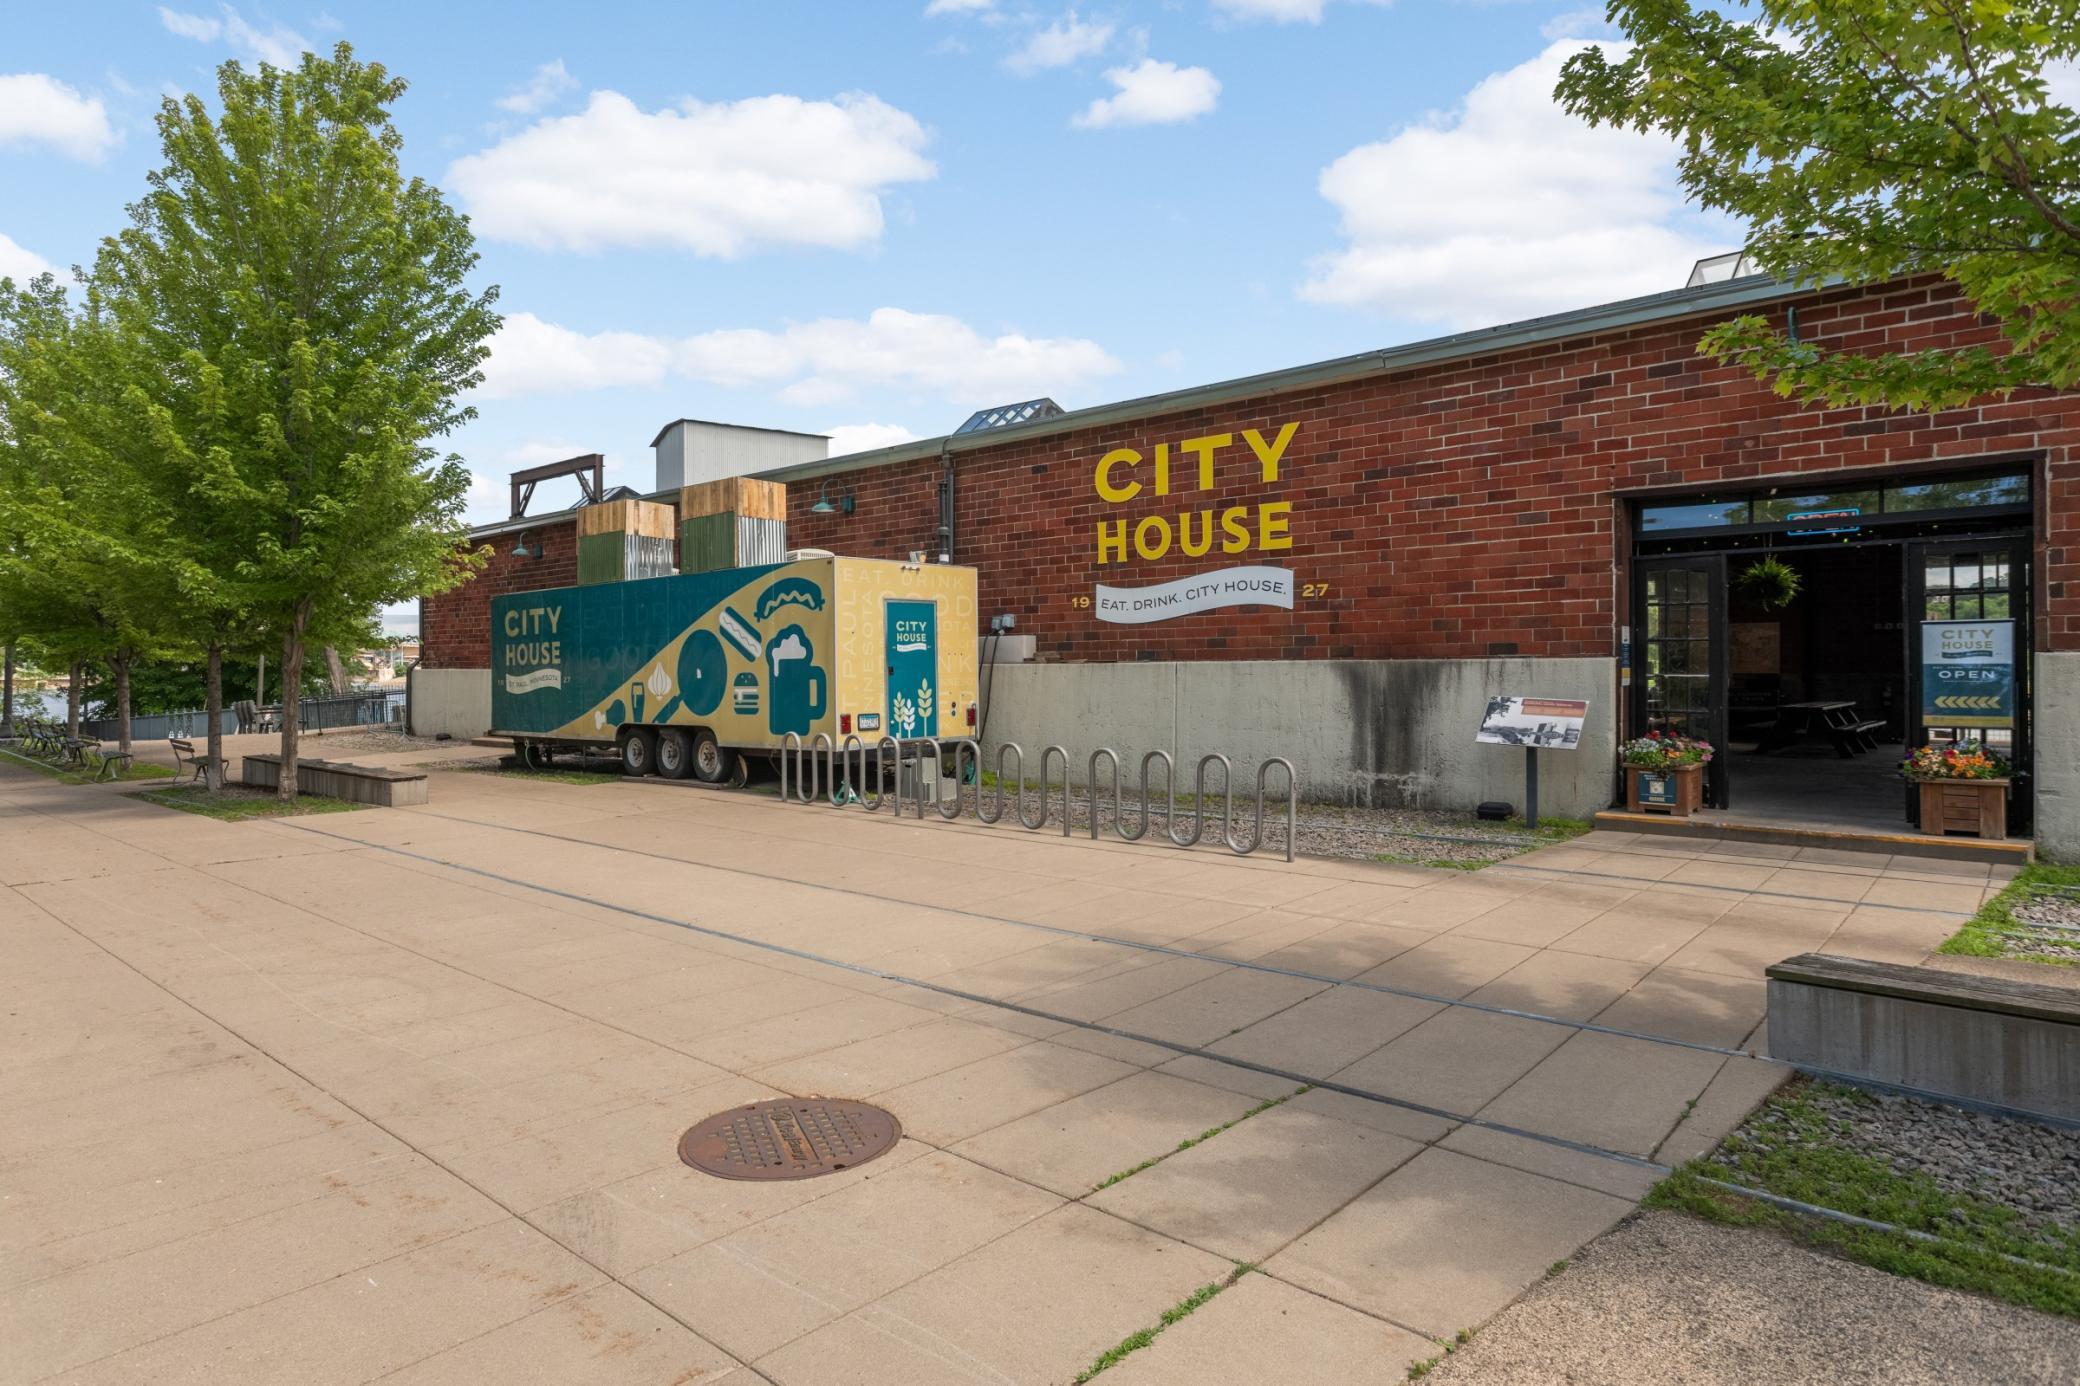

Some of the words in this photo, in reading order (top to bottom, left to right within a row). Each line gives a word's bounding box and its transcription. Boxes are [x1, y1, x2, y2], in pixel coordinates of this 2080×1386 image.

[1095, 421, 1300, 503] CITY
[1096, 501, 1293, 564] HOUSE
[1101, 598, 1130, 611] EAT.
[1133, 595, 1182, 611] DRINK.
[1185, 583, 1219, 601] CITY
[1224, 579, 1287, 596] HOUSE.
[1302, 583, 1329, 597] 27
[1071, 596, 1090, 609] 19
[504, 605, 562, 637] CITY
[896, 620, 927, 632] CITY
[896, 632, 927, 642] HOUSE
[1941, 629, 1995, 640] CITY
[1941, 640, 1993, 650] HOUSE
[506, 641, 561, 666] HOUSE
[1938, 670, 1996, 679] OPEN
